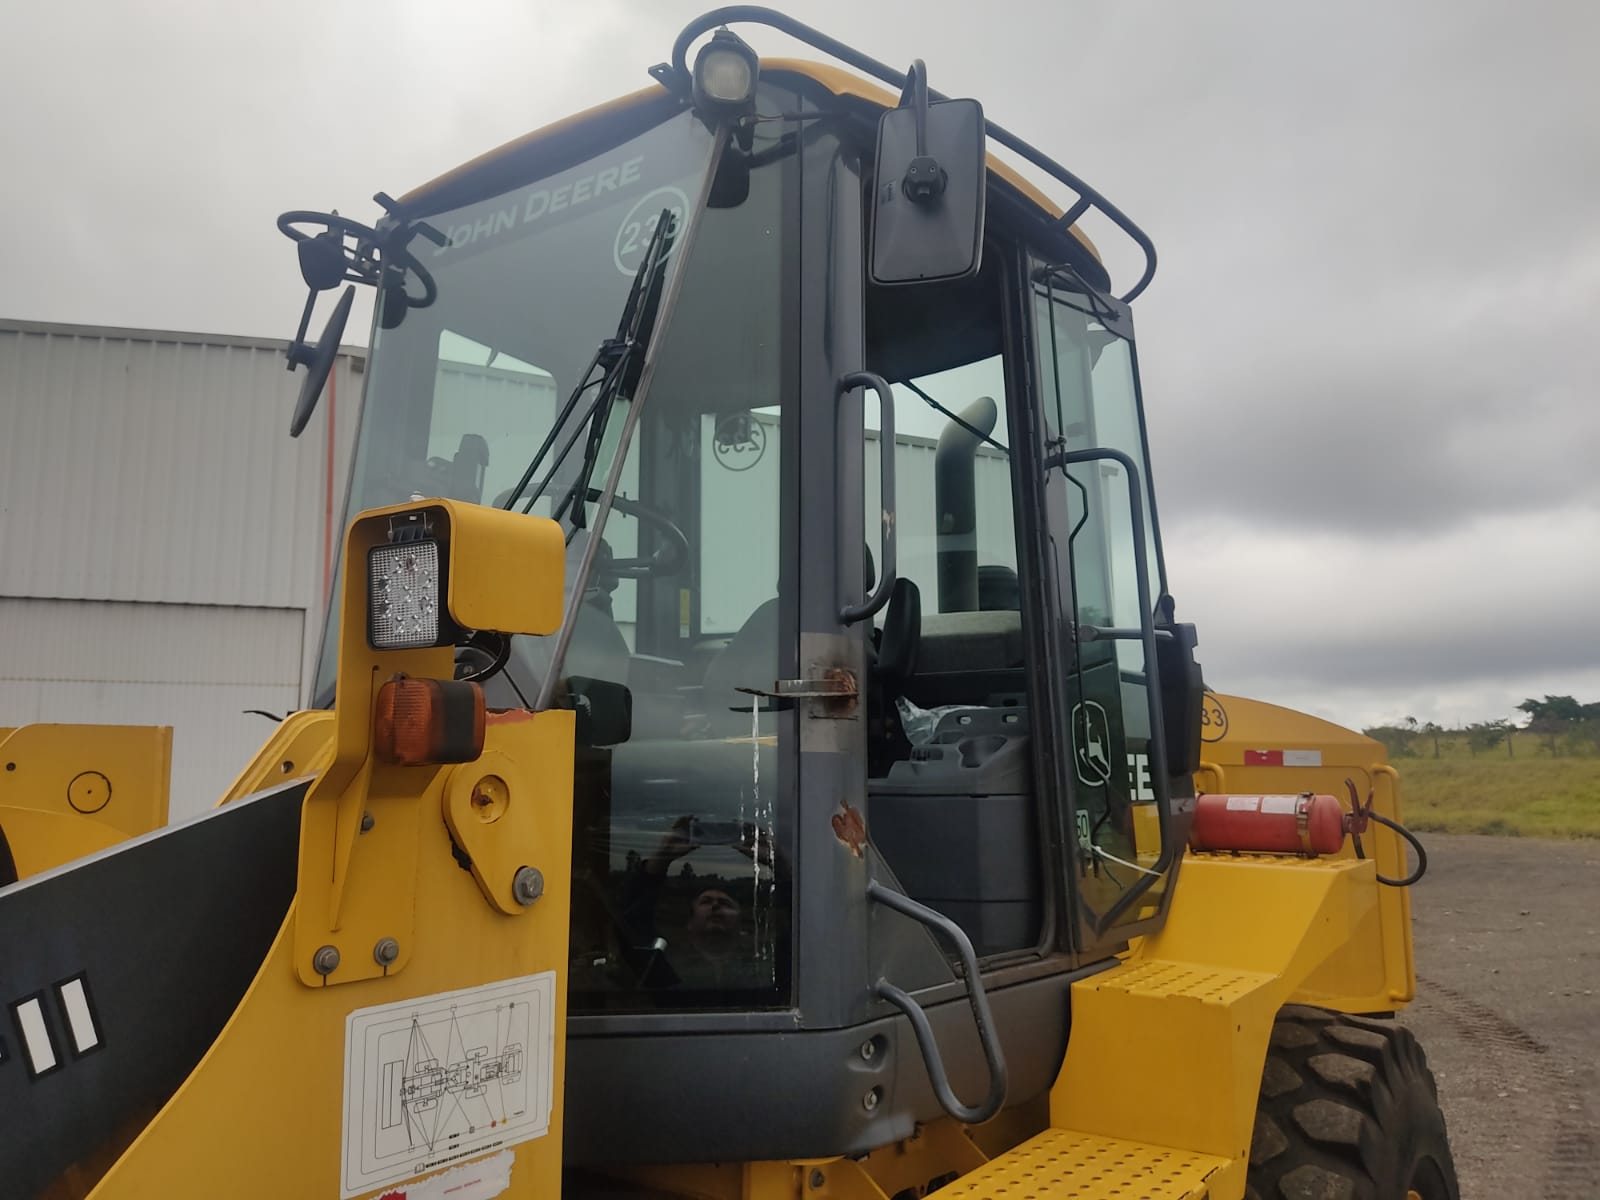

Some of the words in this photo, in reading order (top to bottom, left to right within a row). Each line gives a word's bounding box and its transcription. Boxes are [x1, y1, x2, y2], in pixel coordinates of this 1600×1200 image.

[433, 205, 519, 257] JOHN
[523, 156, 645, 224] DEERE
[1201, 708, 1224, 727] 33
